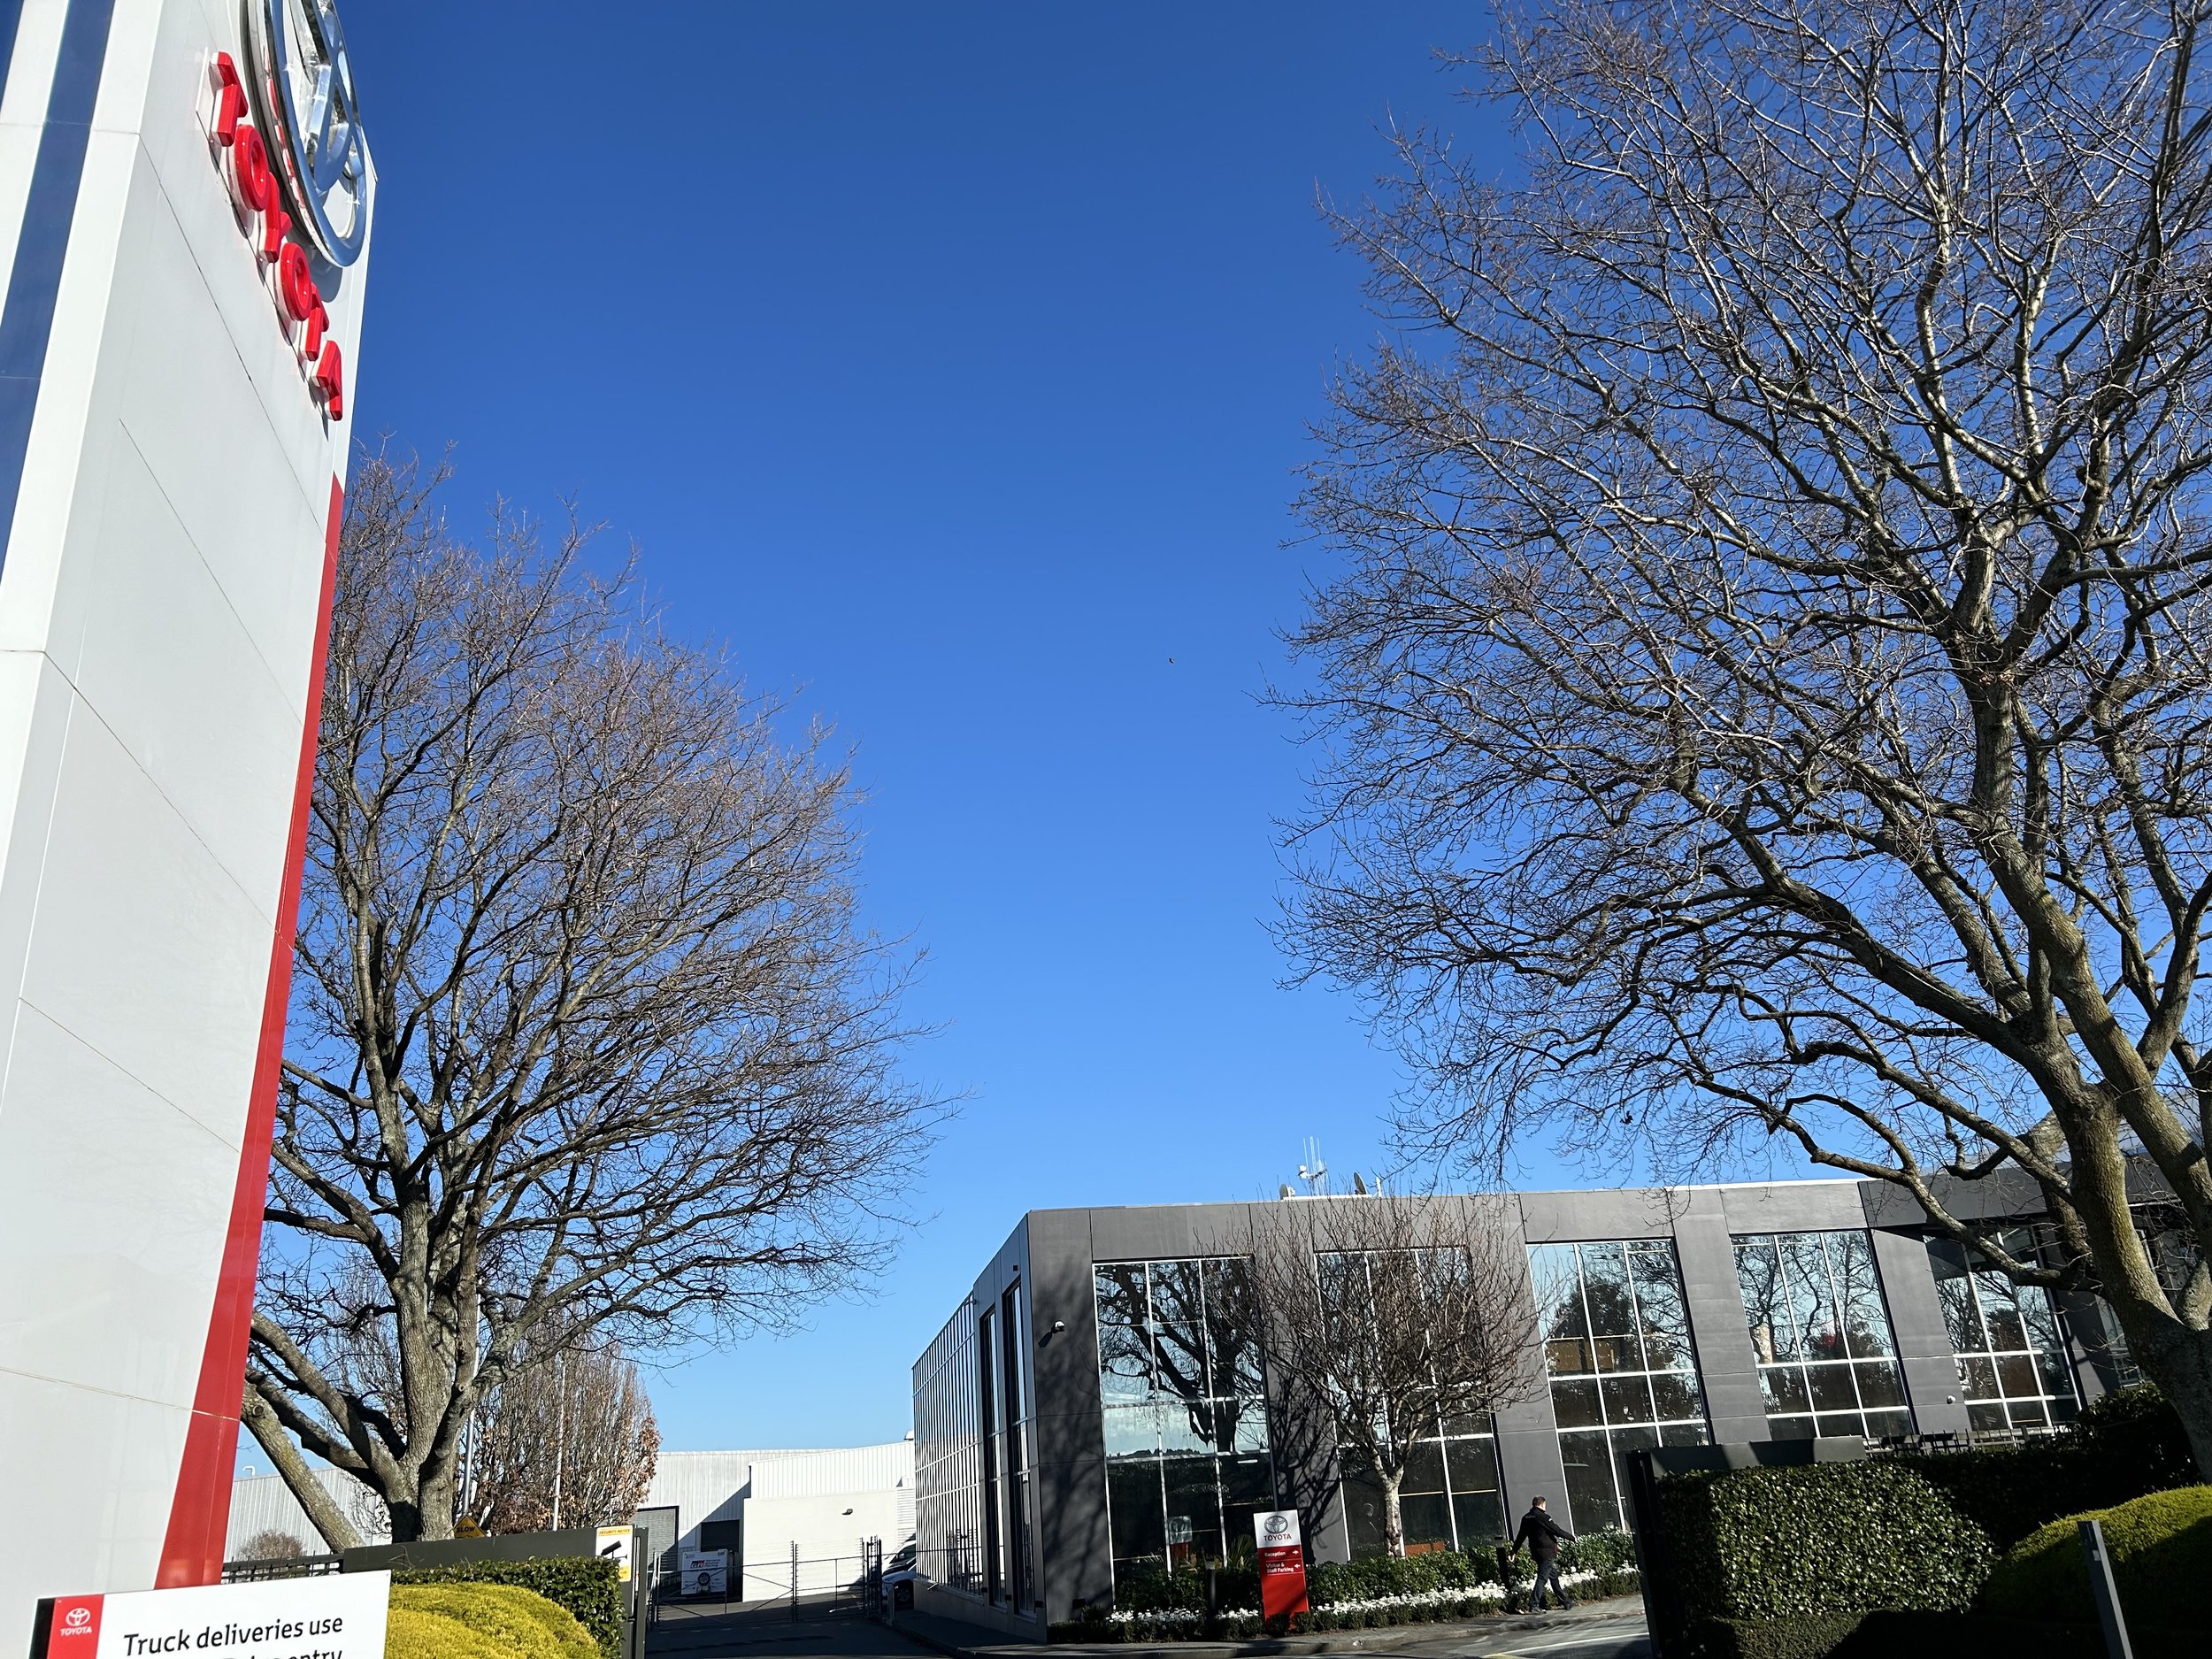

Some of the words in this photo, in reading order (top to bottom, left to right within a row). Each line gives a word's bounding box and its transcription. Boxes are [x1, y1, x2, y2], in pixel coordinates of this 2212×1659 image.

[60, 1625, 93, 1637] TOYOTA
[123, 1628, 191, 1656] Truck
[196, 1618, 303, 1648] deliveries
[308, 1617, 343, 1636] use
[288, 1649, 342, 1659] try
